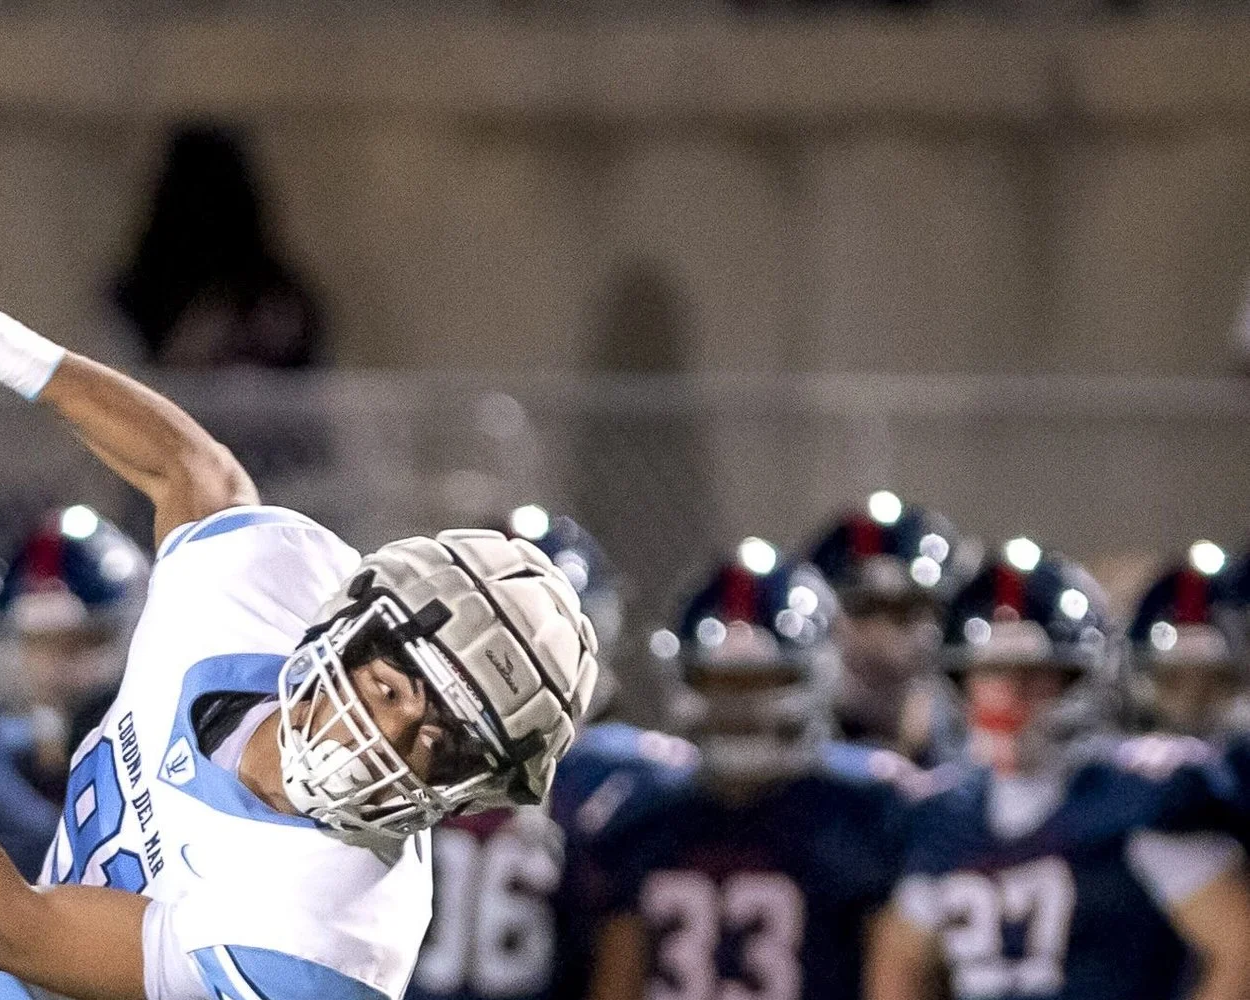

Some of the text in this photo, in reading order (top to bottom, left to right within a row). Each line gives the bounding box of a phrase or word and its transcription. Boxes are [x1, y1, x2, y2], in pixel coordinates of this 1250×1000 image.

[118, 710, 165, 879] CORONA DEL MAR
[940, 856, 1076, 1000] 27
